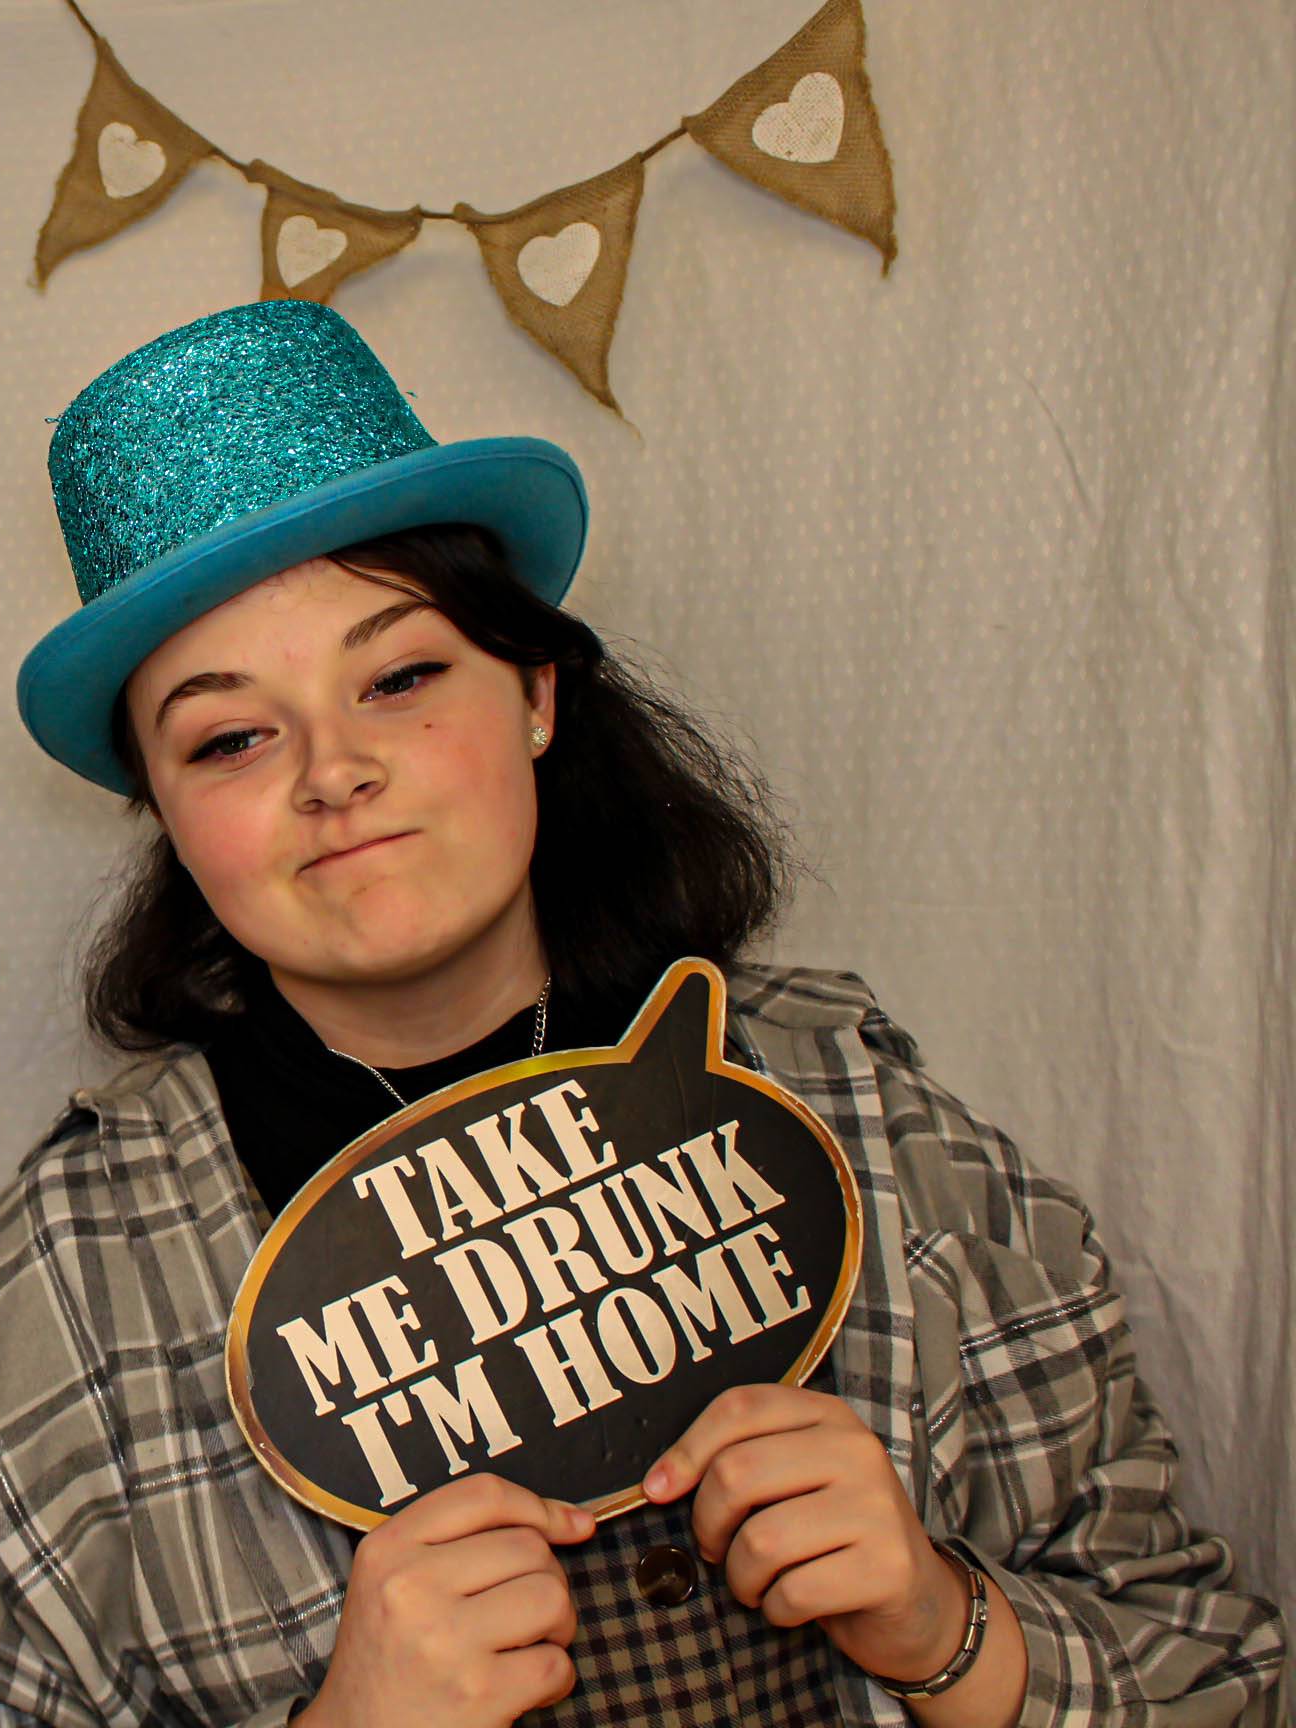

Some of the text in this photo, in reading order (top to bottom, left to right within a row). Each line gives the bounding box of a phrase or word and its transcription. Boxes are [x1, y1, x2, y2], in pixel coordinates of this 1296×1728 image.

[275, 1119, 786, 1417] ME DRUNK
[352, 1079, 618, 1260] TAKE
[340, 1221, 812, 1508] I'M HOME
